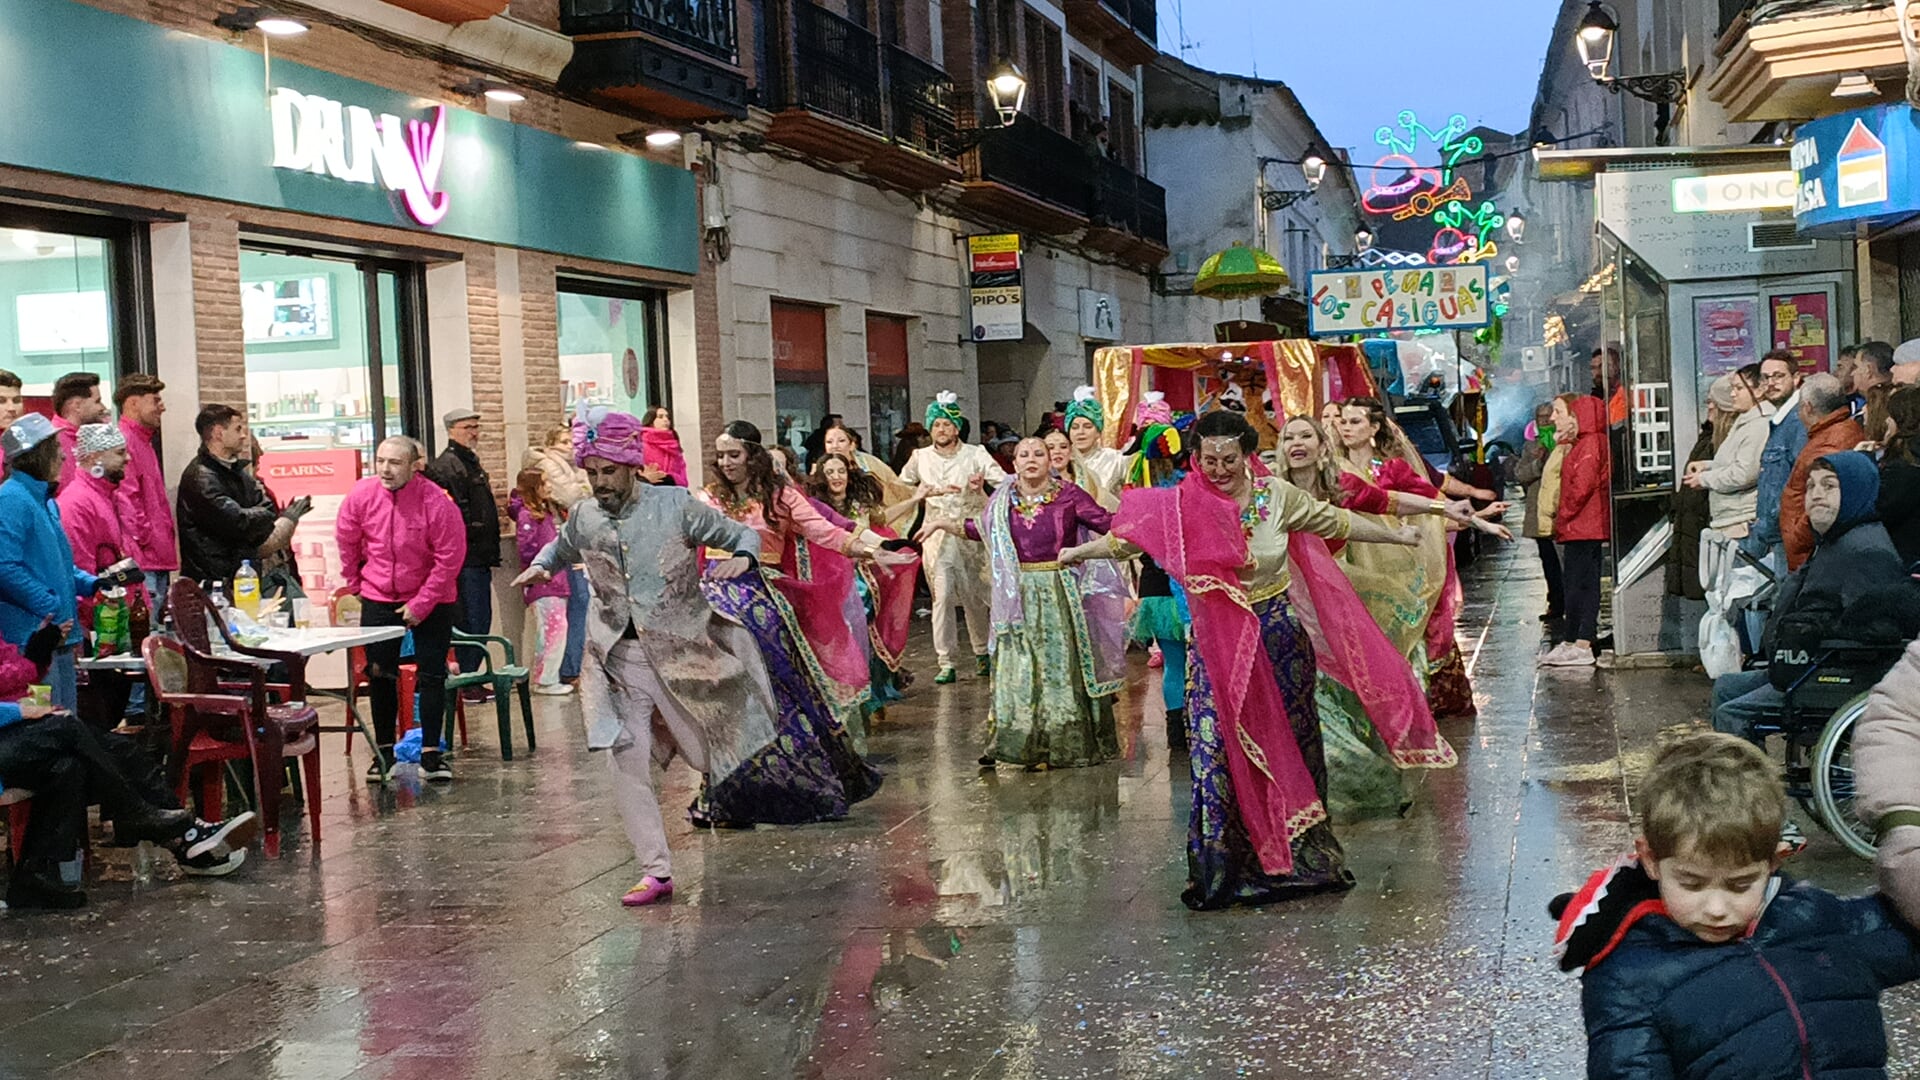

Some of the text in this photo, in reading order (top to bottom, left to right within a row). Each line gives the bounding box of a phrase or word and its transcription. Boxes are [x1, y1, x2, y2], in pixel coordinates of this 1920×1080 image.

[1722, 178, 1796, 201] ONC
[1312, 285, 1350, 320] LOS
[1361, 278, 1484, 328] CASIGUAS
[270, 464, 335, 477] CLARINS
[1774, 649, 1809, 665] FILA
